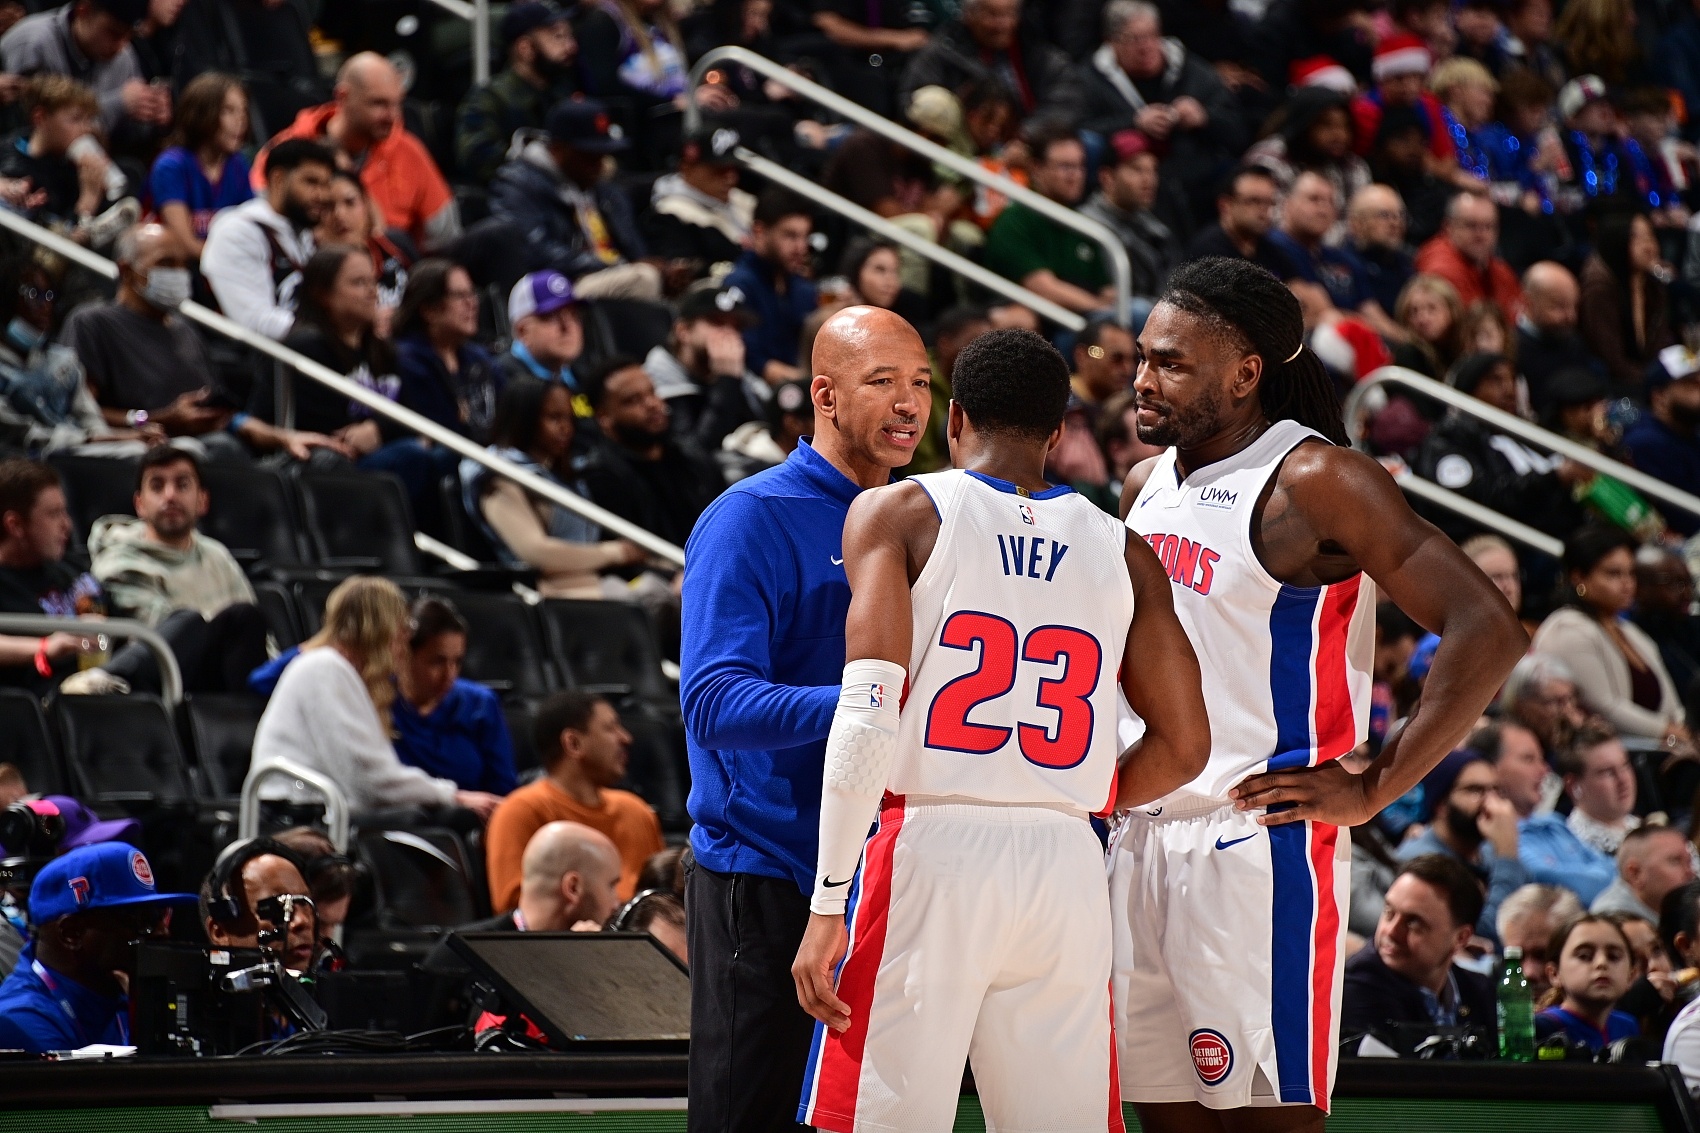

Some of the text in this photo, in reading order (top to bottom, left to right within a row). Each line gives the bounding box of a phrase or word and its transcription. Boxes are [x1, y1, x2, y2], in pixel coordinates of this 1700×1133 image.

[1200, 486, 1239, 505] UWM
[997, 534, 1070, 583] IVEY
[1141, 533, 1222, 597] TONS
[923, 609, 1103, 771] 23
[1193, 1047, 1222, 1057] DETROIT
[1195, 1056, 1224, 1066] PISTONS
